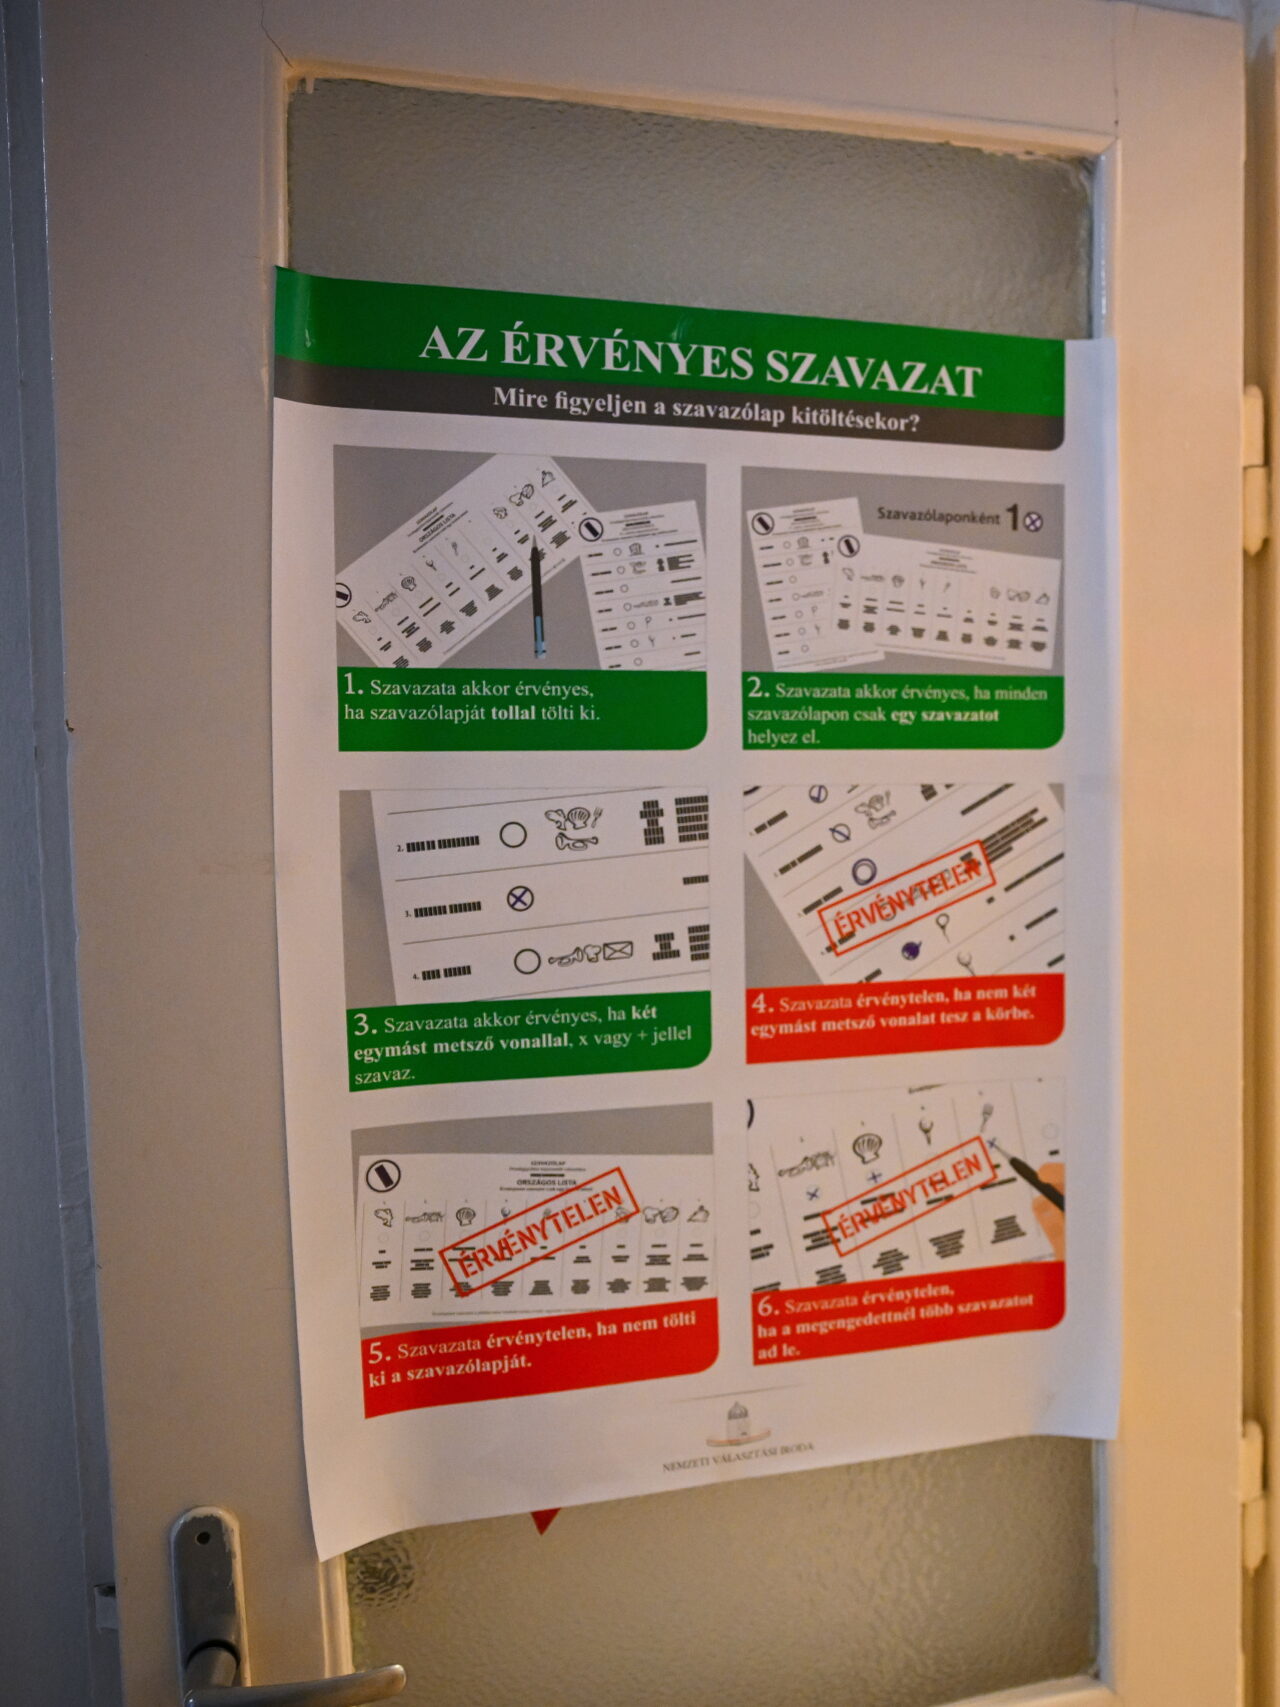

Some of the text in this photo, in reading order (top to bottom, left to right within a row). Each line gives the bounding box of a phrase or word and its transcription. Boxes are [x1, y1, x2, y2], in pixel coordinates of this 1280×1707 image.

[419, 321, 983, 398] AZ ÉRVÉNYES SZAVAZAT
[493, 387, 920, 432] Mire figyeljen a szavazólap kitöltésekor?
[876, 502, 1019, 531] Szavazólaponként 1
[344, 672, 594, 700] 1. Szavazata akkor érvényes,
[747, 675, 1047, 703] 2. Szavazata akkor érvényes, ha minden
[344, 704, 600, 724] ha szavazólapját tollal tölti ki.
[747, 706, 1000, 726] szavazólapon csak egy szavazatot
[747, 728, 821, 747] helyez el.
[833, 858, 983, 937] ÉRVÉNYTELEN
[751, 984, 1036, 1014] 4. Szavazata érvénytelen, ha nem két
[353, 1005, 658, 1036] 3. Szavazata akkor érvényes, ha két
[751, 1018, 816, 1039] egymást
[880, 1011, 935, 1027] vonalat
[940, 1009, 968, 1023] tesz
[972, 1011, 981, 1021] a
[353, 1040, 427, 1064] egymást
[433, 1036, 494, 1054] metsző
[500, 1032, 574, 1052] vonallal,
[578, 1036, 588, 1046] x
[594, 1031, 632, 1048] vagy
[652, 1025, 692, 1046] jellel
[354, 1067, 416, 1085] szavaz.
[837, 1154, 983, 1239] ÉRVÉNYTELEN
[457, 1186, 624, 1278] ÉRVÉNYTELEN
[757, 1283, 955, 1317] 6. Szavazata érvénytelen,
[757, 1294, 1034, 1338] ha a megengedettnél több szavazatot
[368, 1310, 696, 1364] 5. Szavazata érvénytelen, ha nem tölti
[758, 1343, 800, 1360] ad le.
[369, 1355, 532, 1388] ki a szavazólapját.
[663, 1457, 709, 1472] NEMZETI
[712, 1444, 777, 1465] VÁLASZTÁSI
